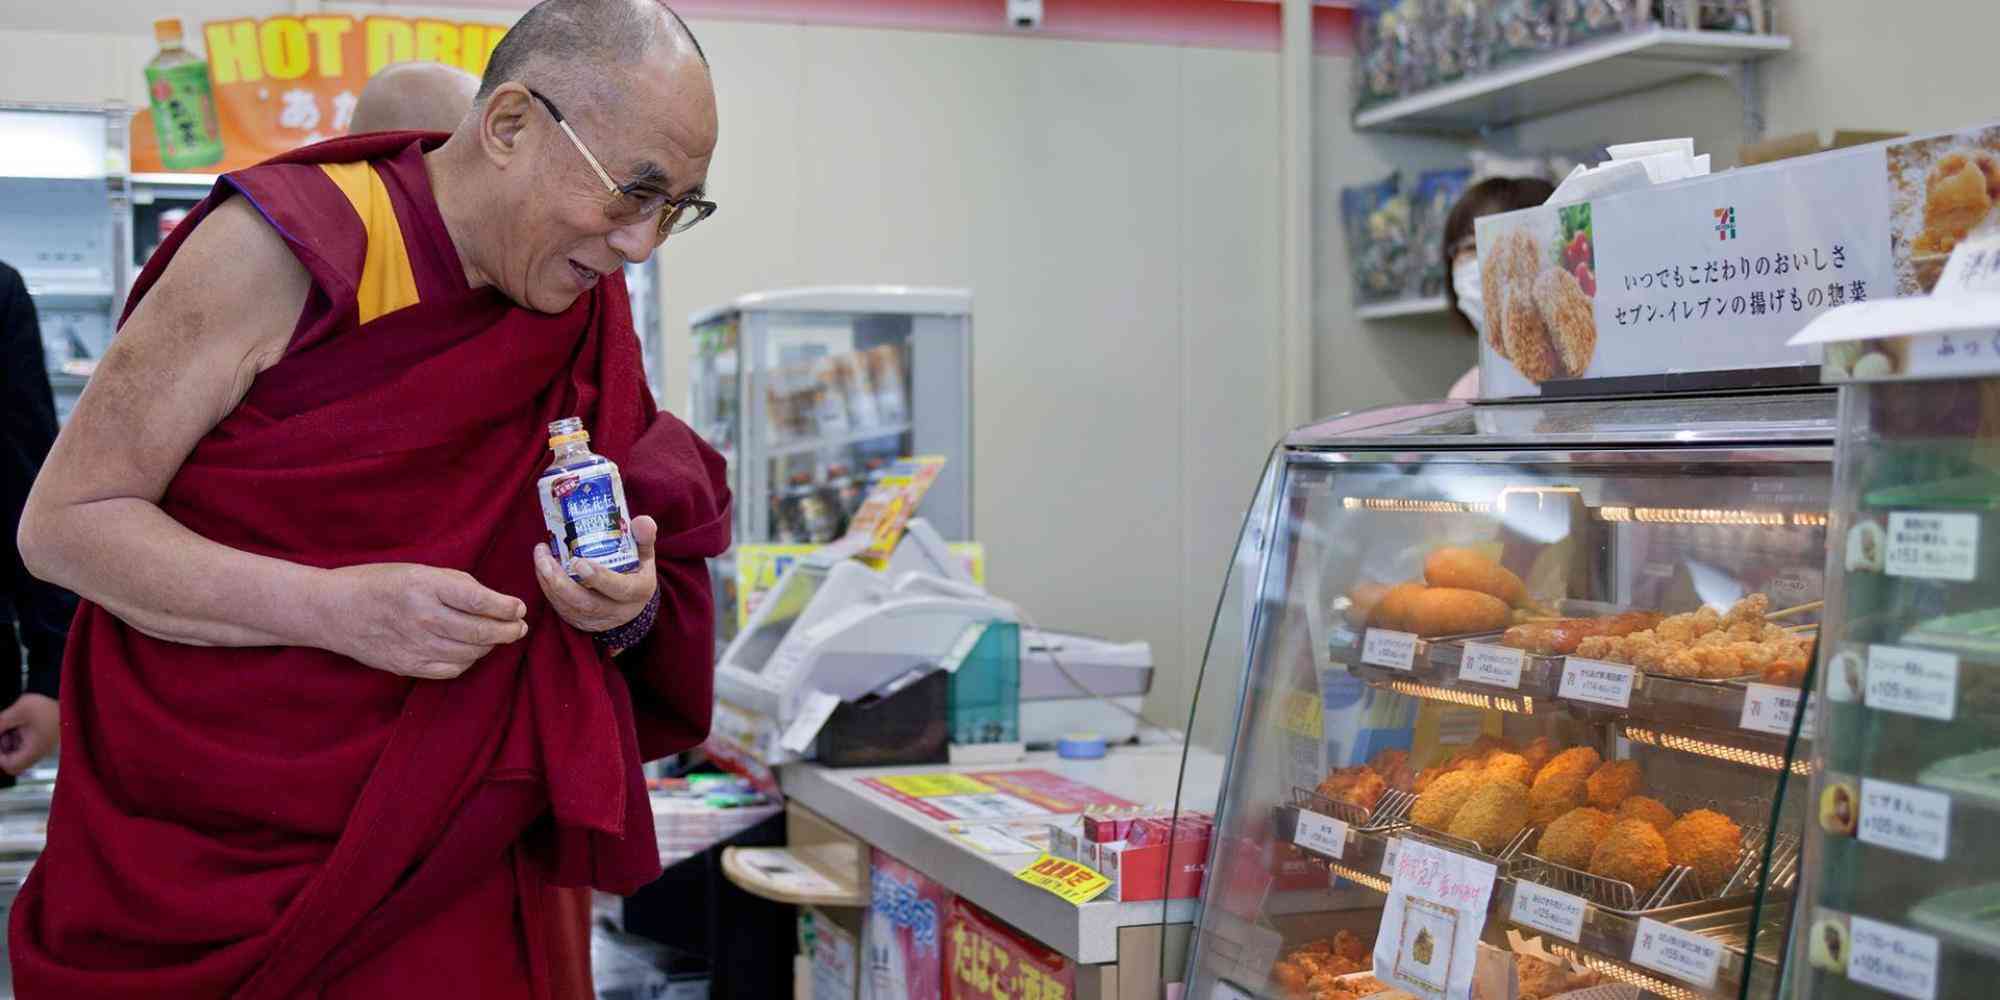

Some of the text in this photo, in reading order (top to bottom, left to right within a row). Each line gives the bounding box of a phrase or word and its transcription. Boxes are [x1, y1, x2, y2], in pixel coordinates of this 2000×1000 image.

[206, 17, 508, 84] HOT DRI
[1624, 245, 1845, 291] いつでもこだわりのおいしさ
